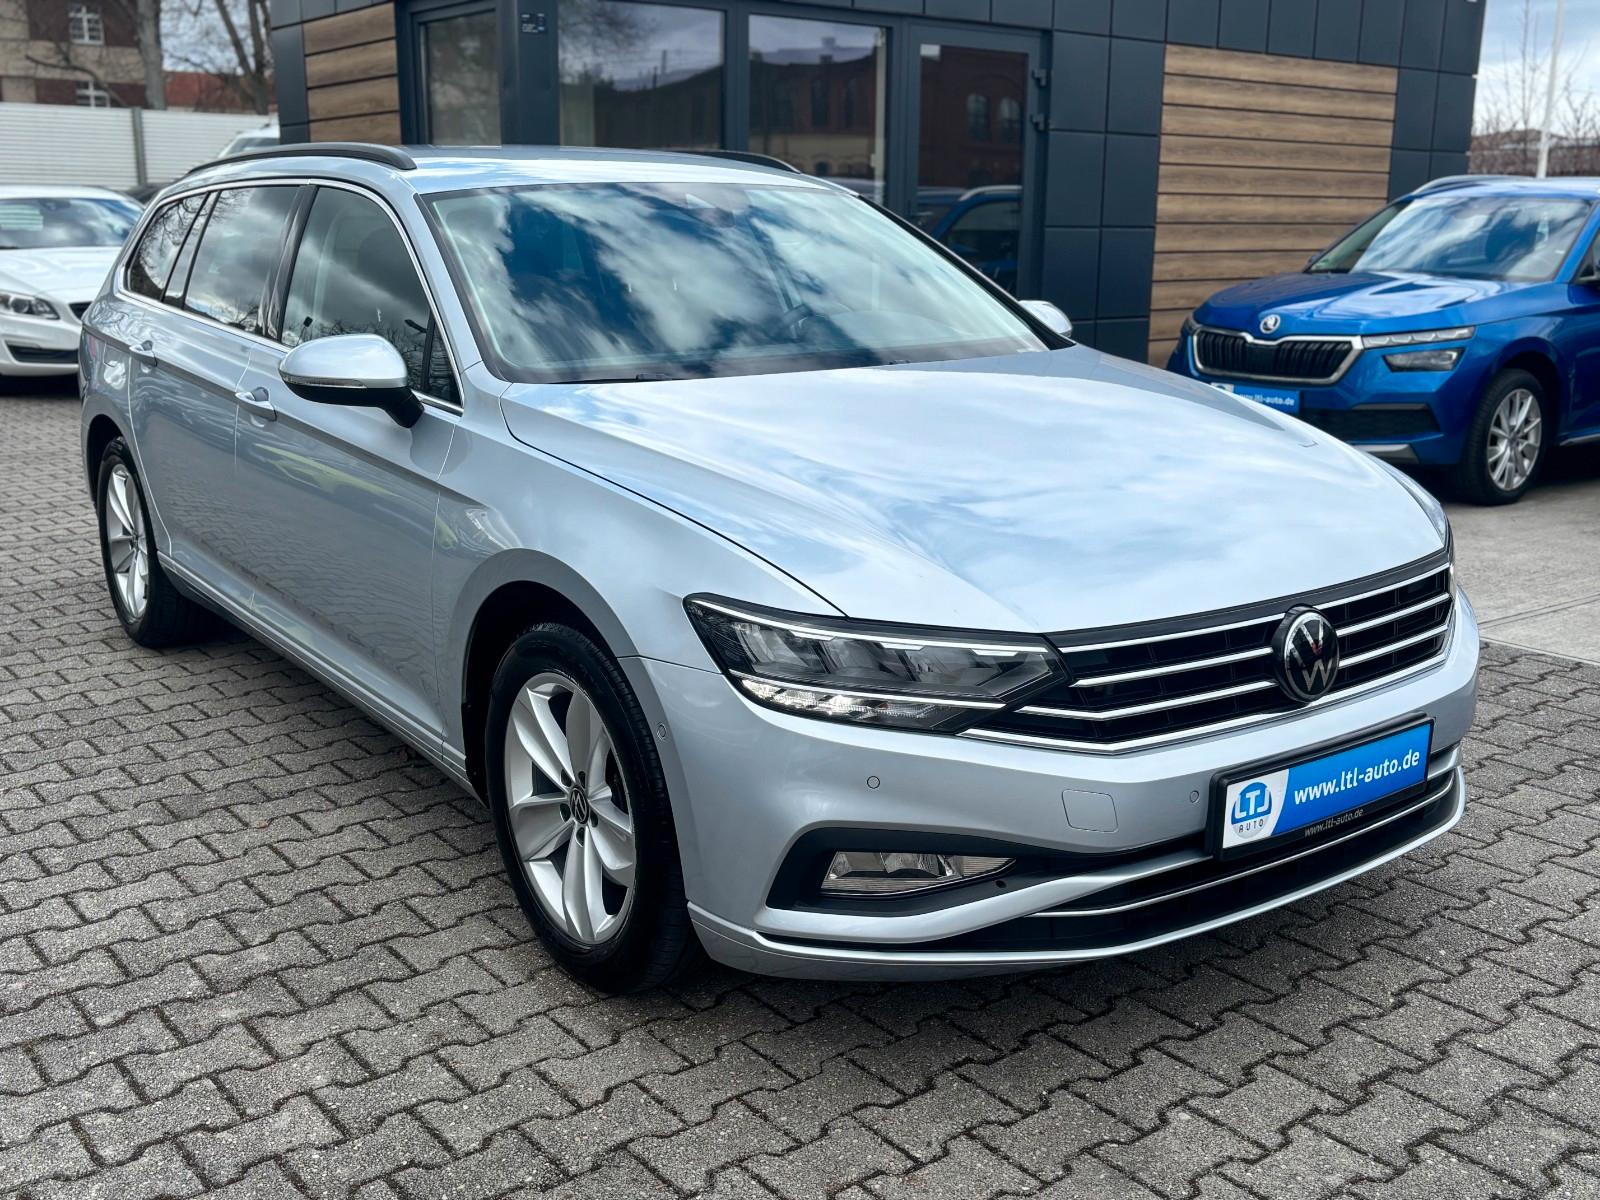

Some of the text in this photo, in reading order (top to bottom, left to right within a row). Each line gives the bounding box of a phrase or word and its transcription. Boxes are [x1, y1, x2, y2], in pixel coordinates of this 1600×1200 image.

[1293, 749, 1420, 805] www.ltl-auto.de
[1238, 818, 1264, 833] AUTO
[1304, 808, 1364, 837] www.ltl-auto.de
